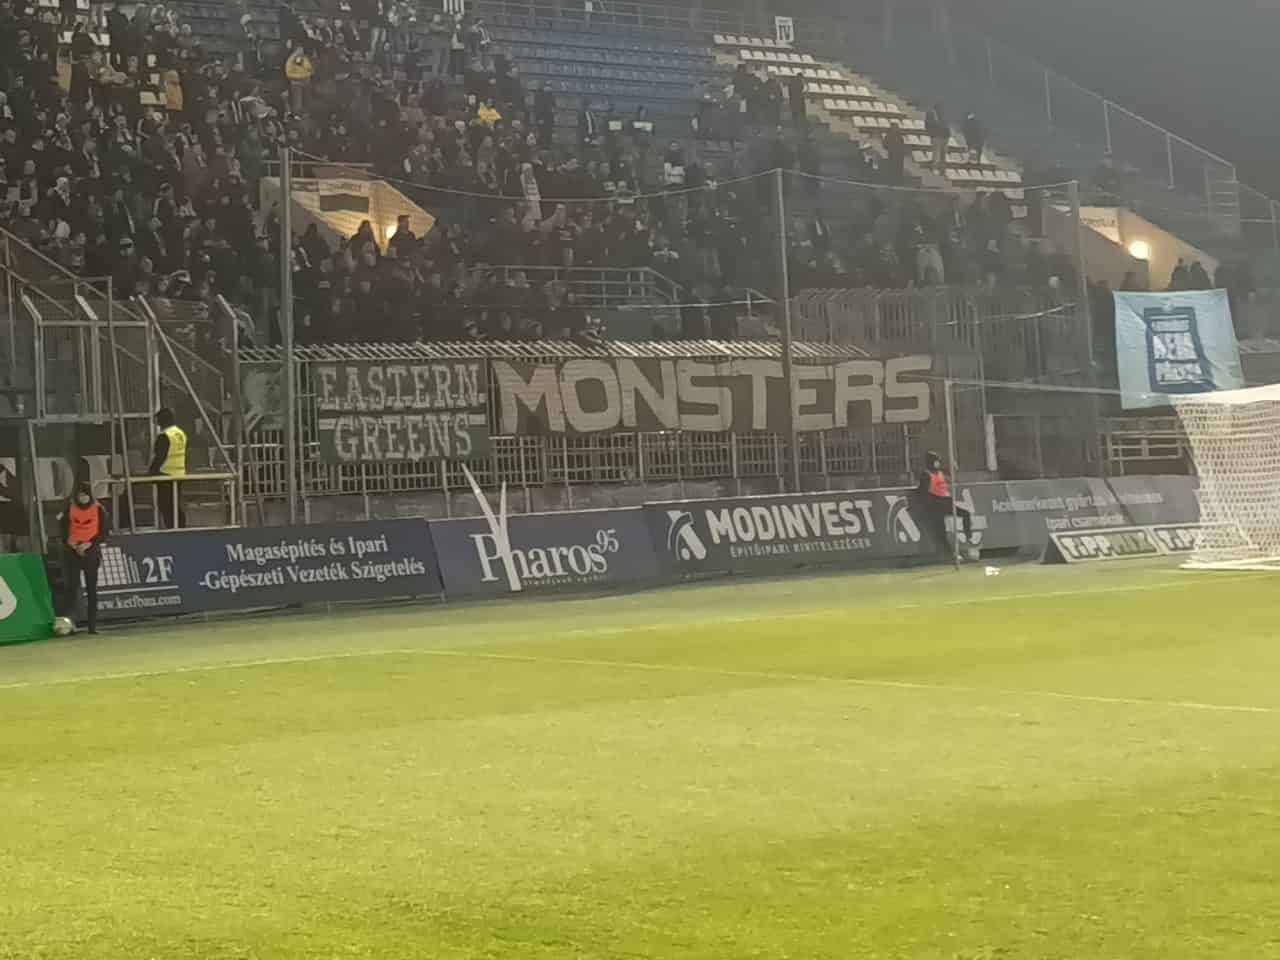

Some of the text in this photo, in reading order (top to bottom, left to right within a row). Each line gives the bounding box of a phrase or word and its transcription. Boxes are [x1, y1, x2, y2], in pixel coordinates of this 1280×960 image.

[318, 363, 486, 411] EASTERN
[492, 355, 934, 434] MONSTERS
[333, 414, 473, 462] GREENS
[705, 499, 876, 544] MODINVEST
[142, 555, 174, 583] 2F
[225, 534, 389, 565] Magasépítés és Ipari
[286, 561, 349, 584] Vezeték
[351, 556, 426, 582] Szigetelés
